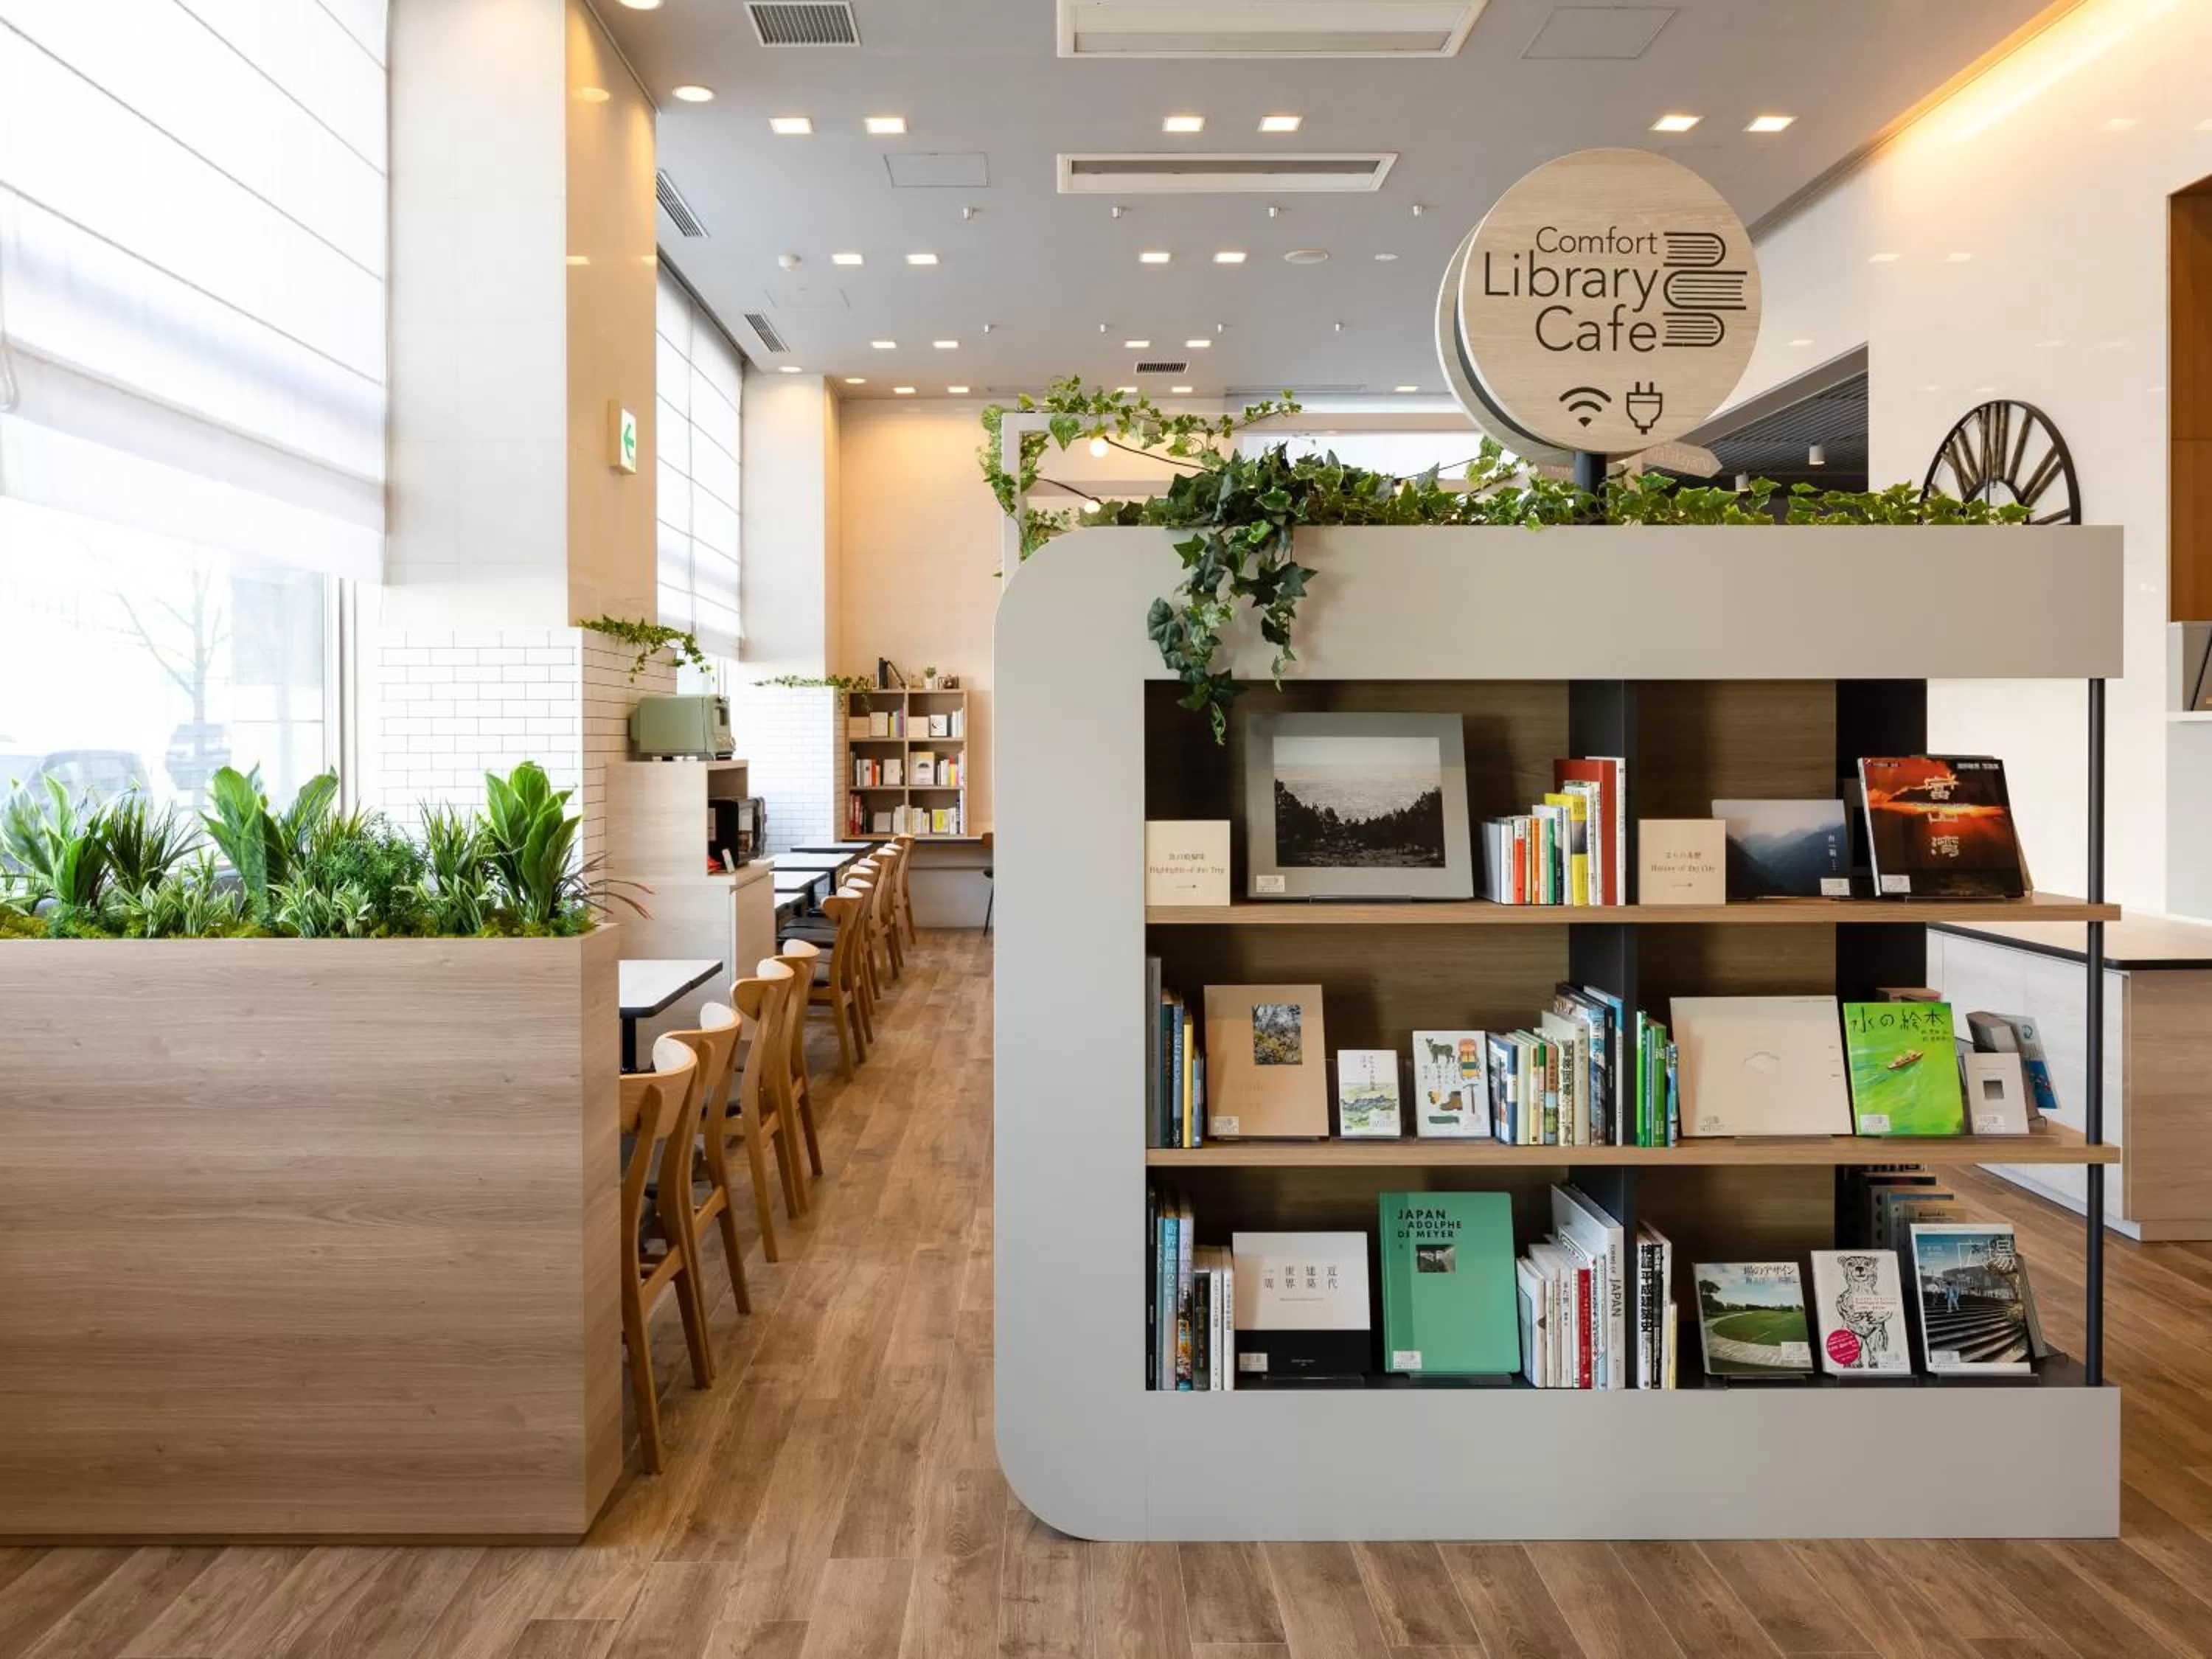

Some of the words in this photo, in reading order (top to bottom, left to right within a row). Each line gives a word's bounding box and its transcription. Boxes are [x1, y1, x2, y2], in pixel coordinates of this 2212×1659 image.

[1536, 226, 1658, 254] Comfort
[1484, 249, 1658, 313] Library
[1536, 304, 1657, 352] Cafe
[1850, 1006, 1945, 1034] 水の絵本
[1398, 1209, 1446, 1220] JAPAN
[1610, 1279, 1622, 1318] JAPAN
